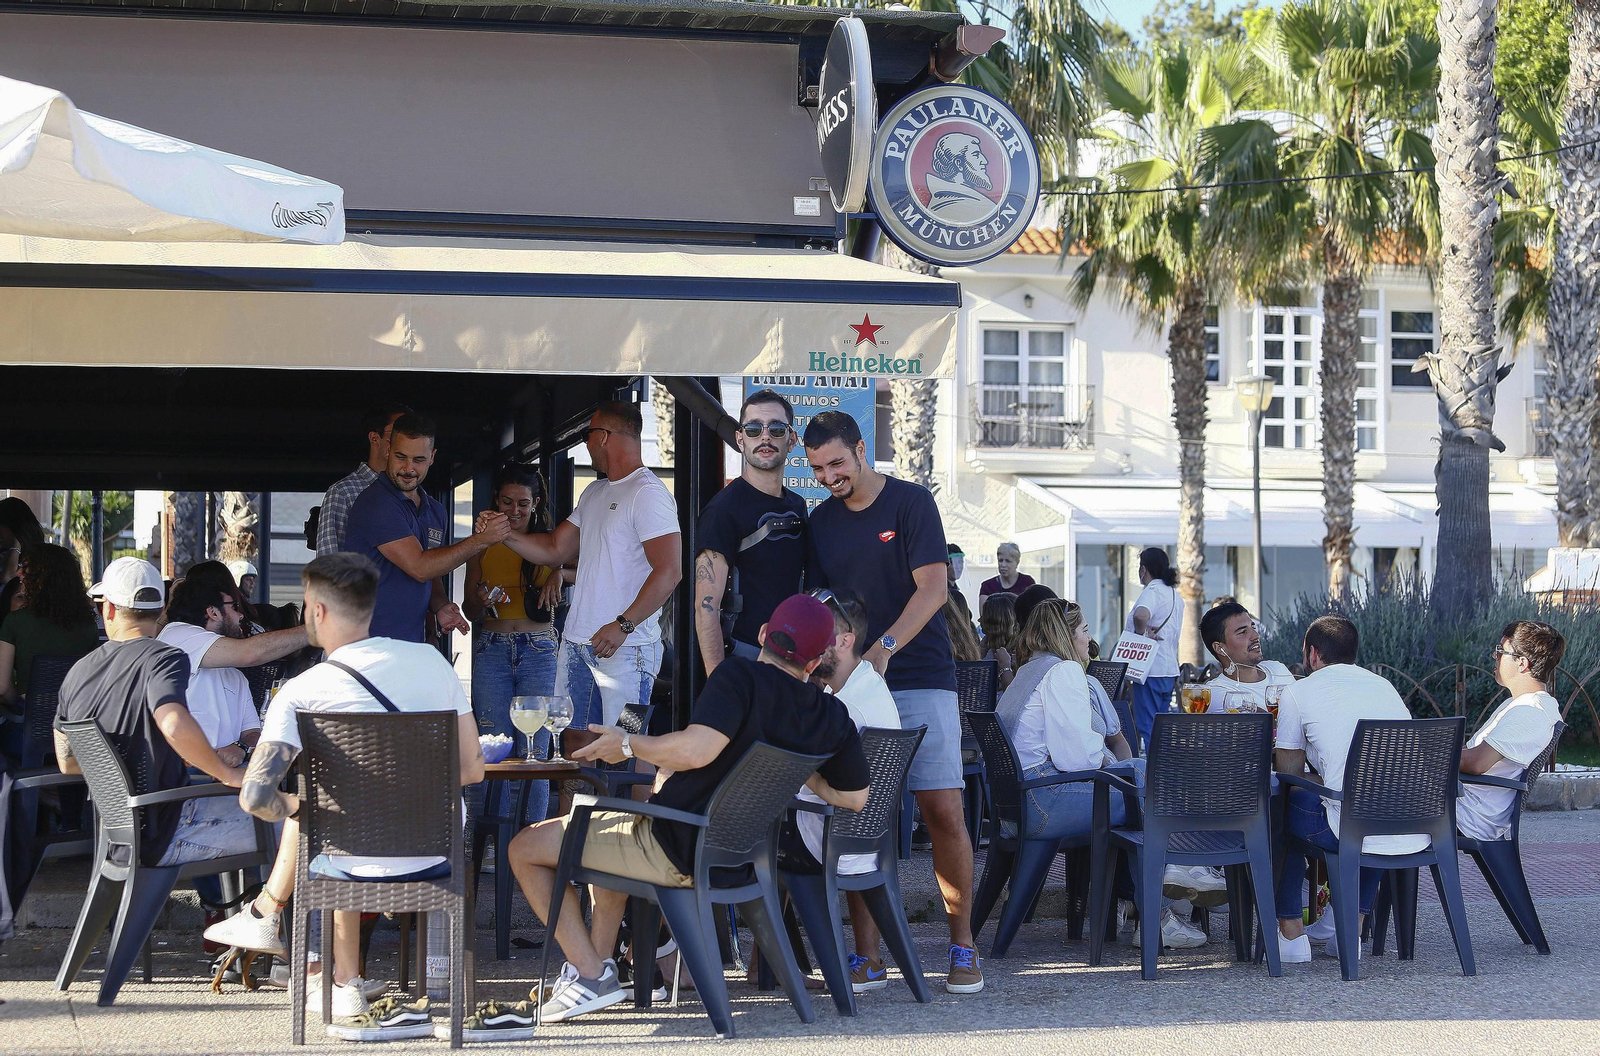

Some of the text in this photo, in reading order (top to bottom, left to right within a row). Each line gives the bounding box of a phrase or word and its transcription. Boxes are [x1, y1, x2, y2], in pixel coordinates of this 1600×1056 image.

[885, 97, 1023, 161] PAULANER
[898, 202, 1018, 247] MÜNCHEN
[808, 351, 922, 374] Heineken
[1116, 648, 1150, 661] TODO!
[1130, 642, 1152, 650] QUIERO
